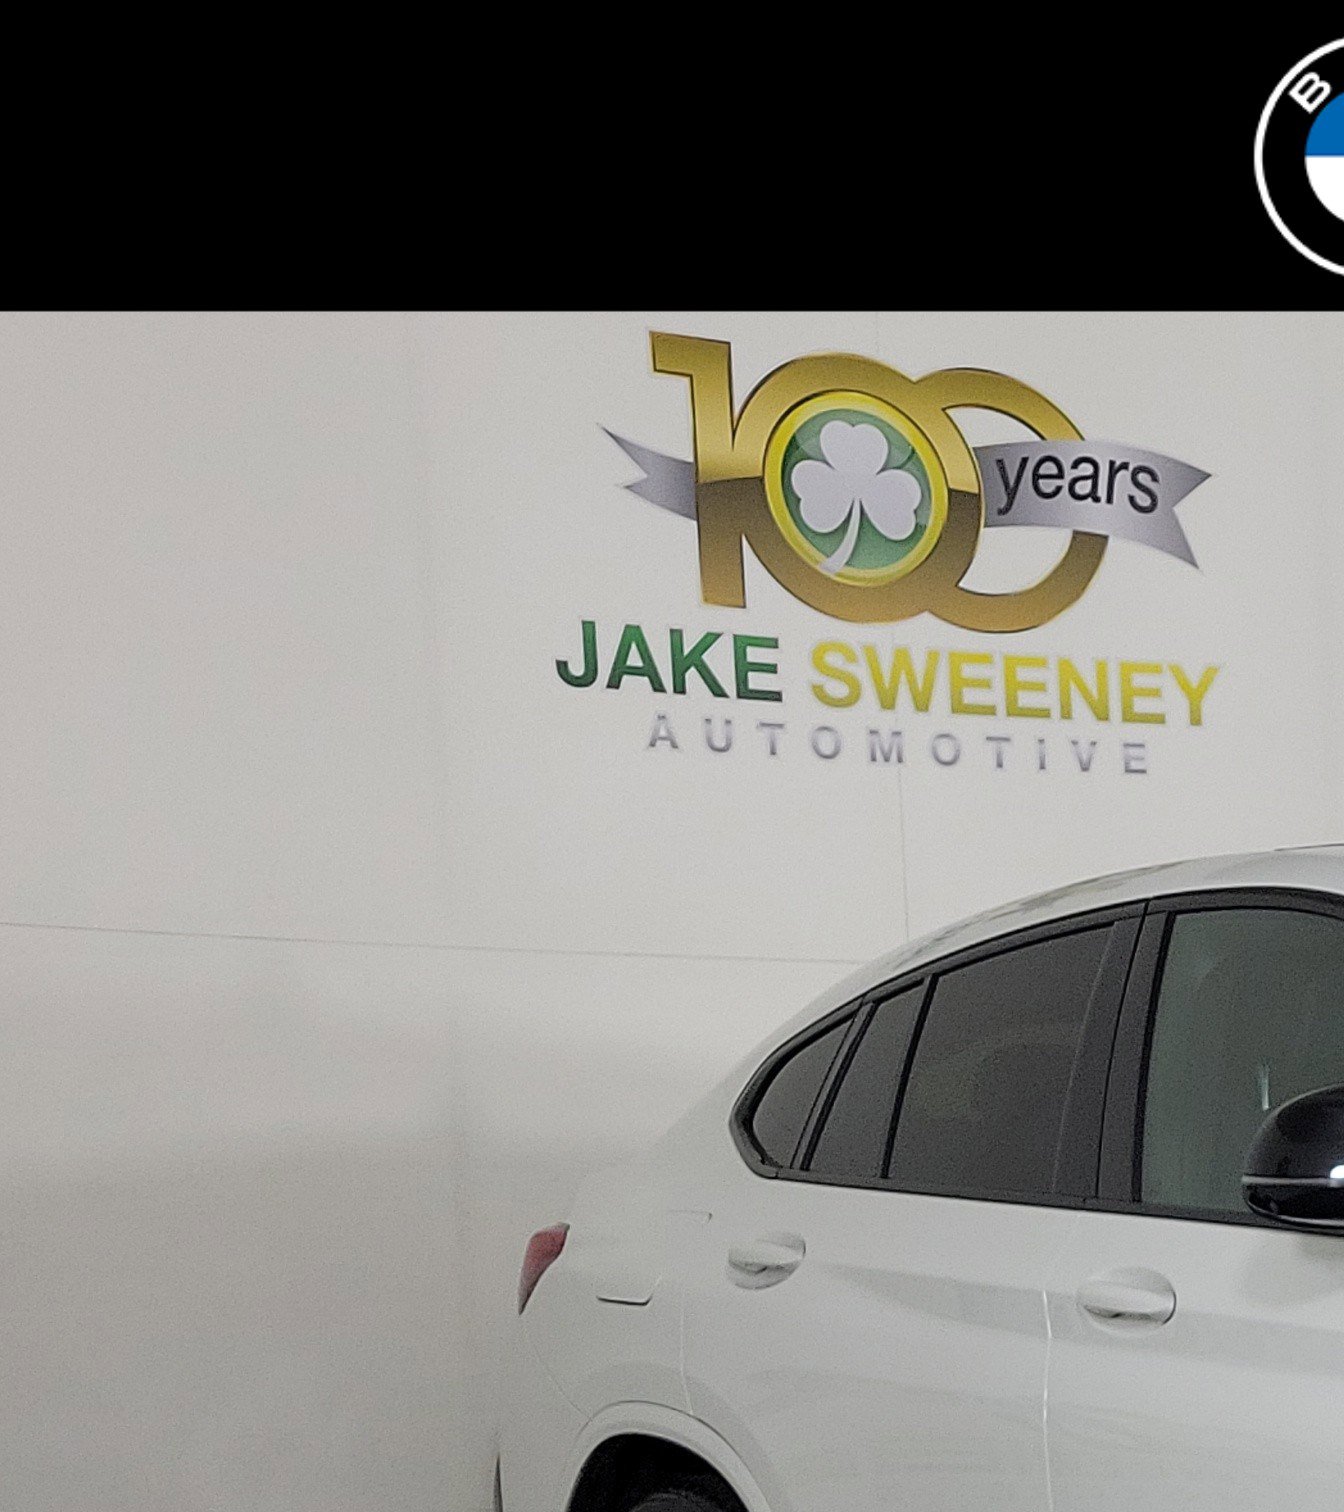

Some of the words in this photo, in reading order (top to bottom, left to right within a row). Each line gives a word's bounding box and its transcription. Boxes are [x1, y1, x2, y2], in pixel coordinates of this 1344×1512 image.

[996, 453, 1160, 514] years
[555, 619, 783, 702] JAKE
[810, 642, 1220, 726] SWEENEY
[647, 714, 1148, 774] AUTOMOTIVE
